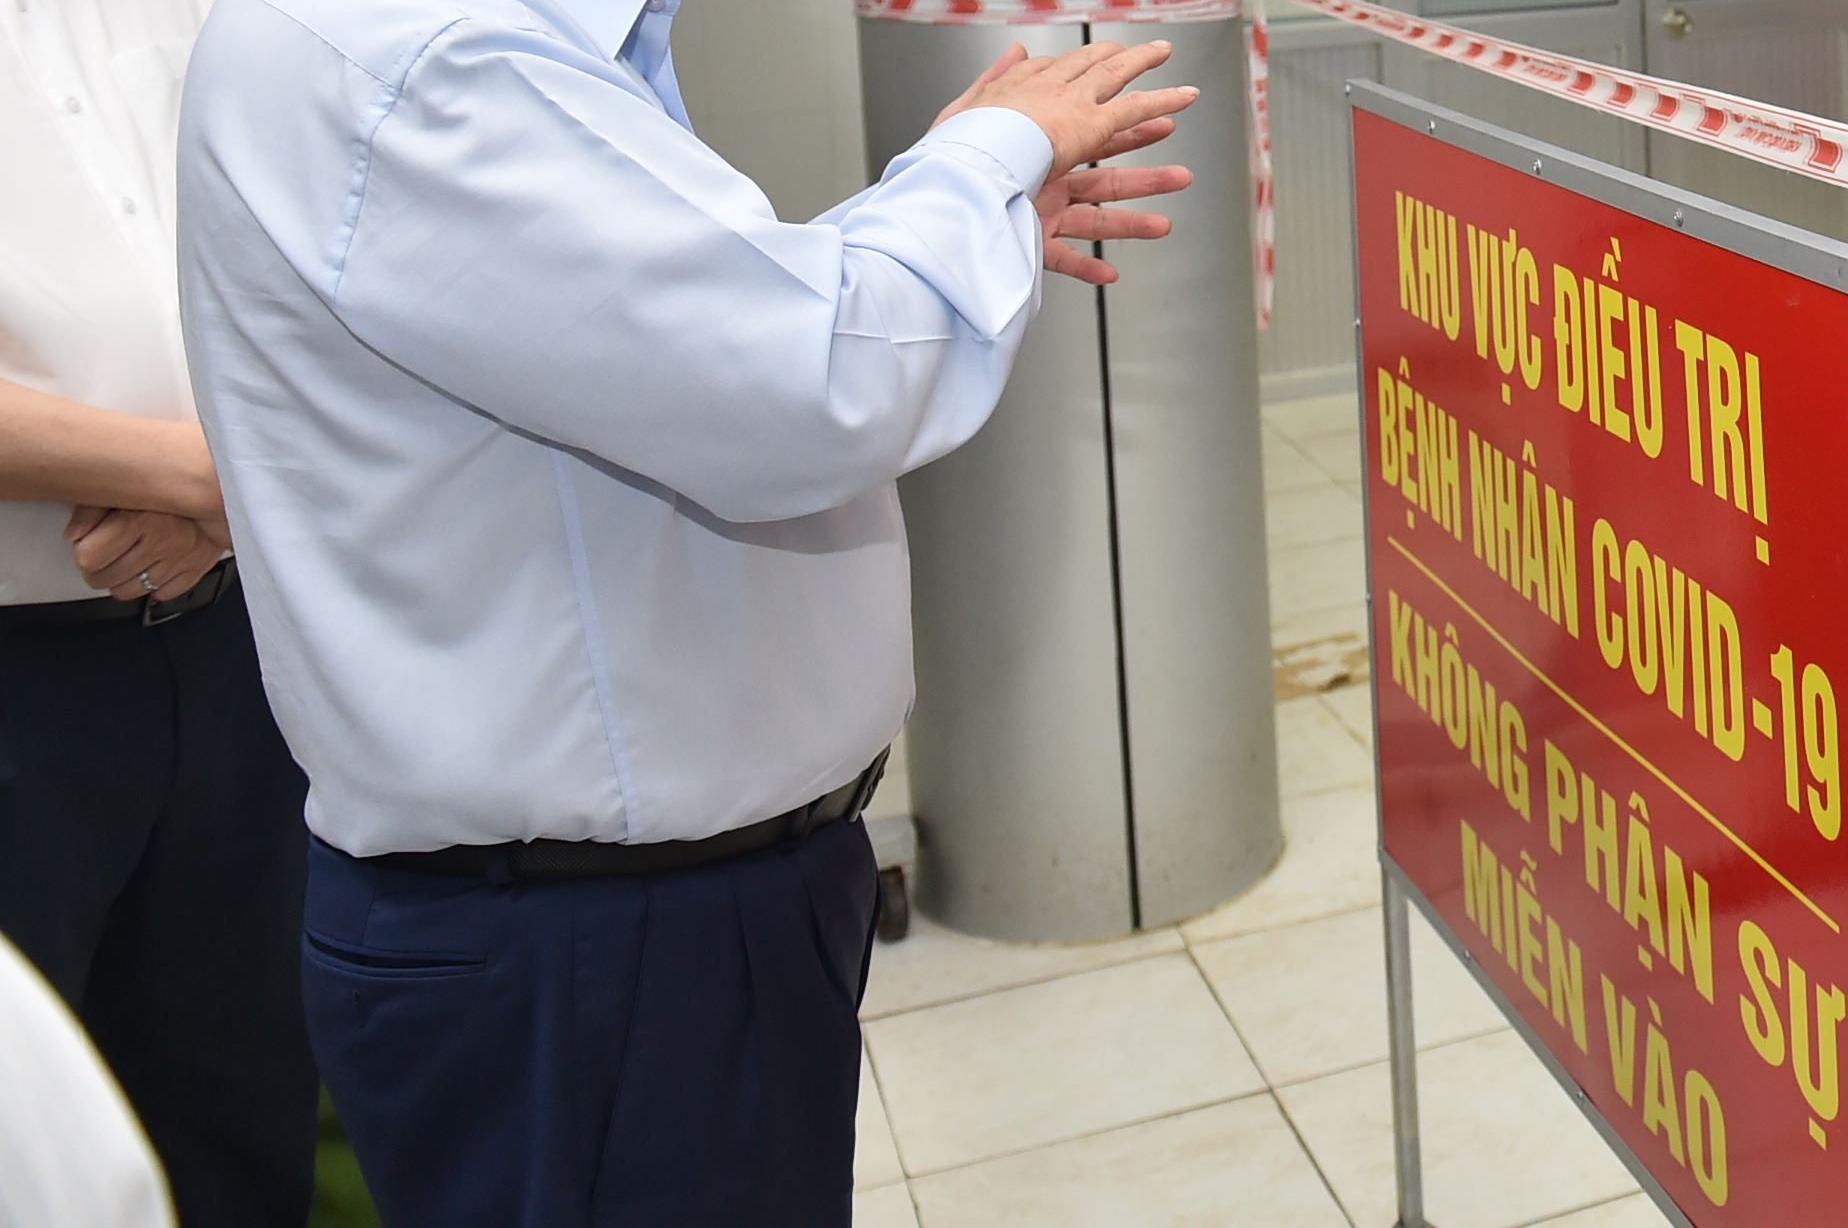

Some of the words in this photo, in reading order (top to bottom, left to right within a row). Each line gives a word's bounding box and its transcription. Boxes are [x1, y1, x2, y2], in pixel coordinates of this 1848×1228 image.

[1394, 191, 1460, 341] KHU
[1466, 222, 1542, 405] VỰC
[1553, 236, 1663, 459] ĐIỀU
[1674, 319, 1770, 565] TRỊ
[1378, 357, 1462, 540] BỆNH
[1468, 432, 1579, 638] NHÂN
[1592, 518, 1841, 841] COVID-19
[1389, 591, 1530, 820] KHÔNG
[1545, 741, 1714, 1002] PHẬN
[1738, 920, 1846, 1148] SỰ
[1462, 821, 1587, 1051] MIỄN
[1601, 976, 1728, 1206] VÀO
